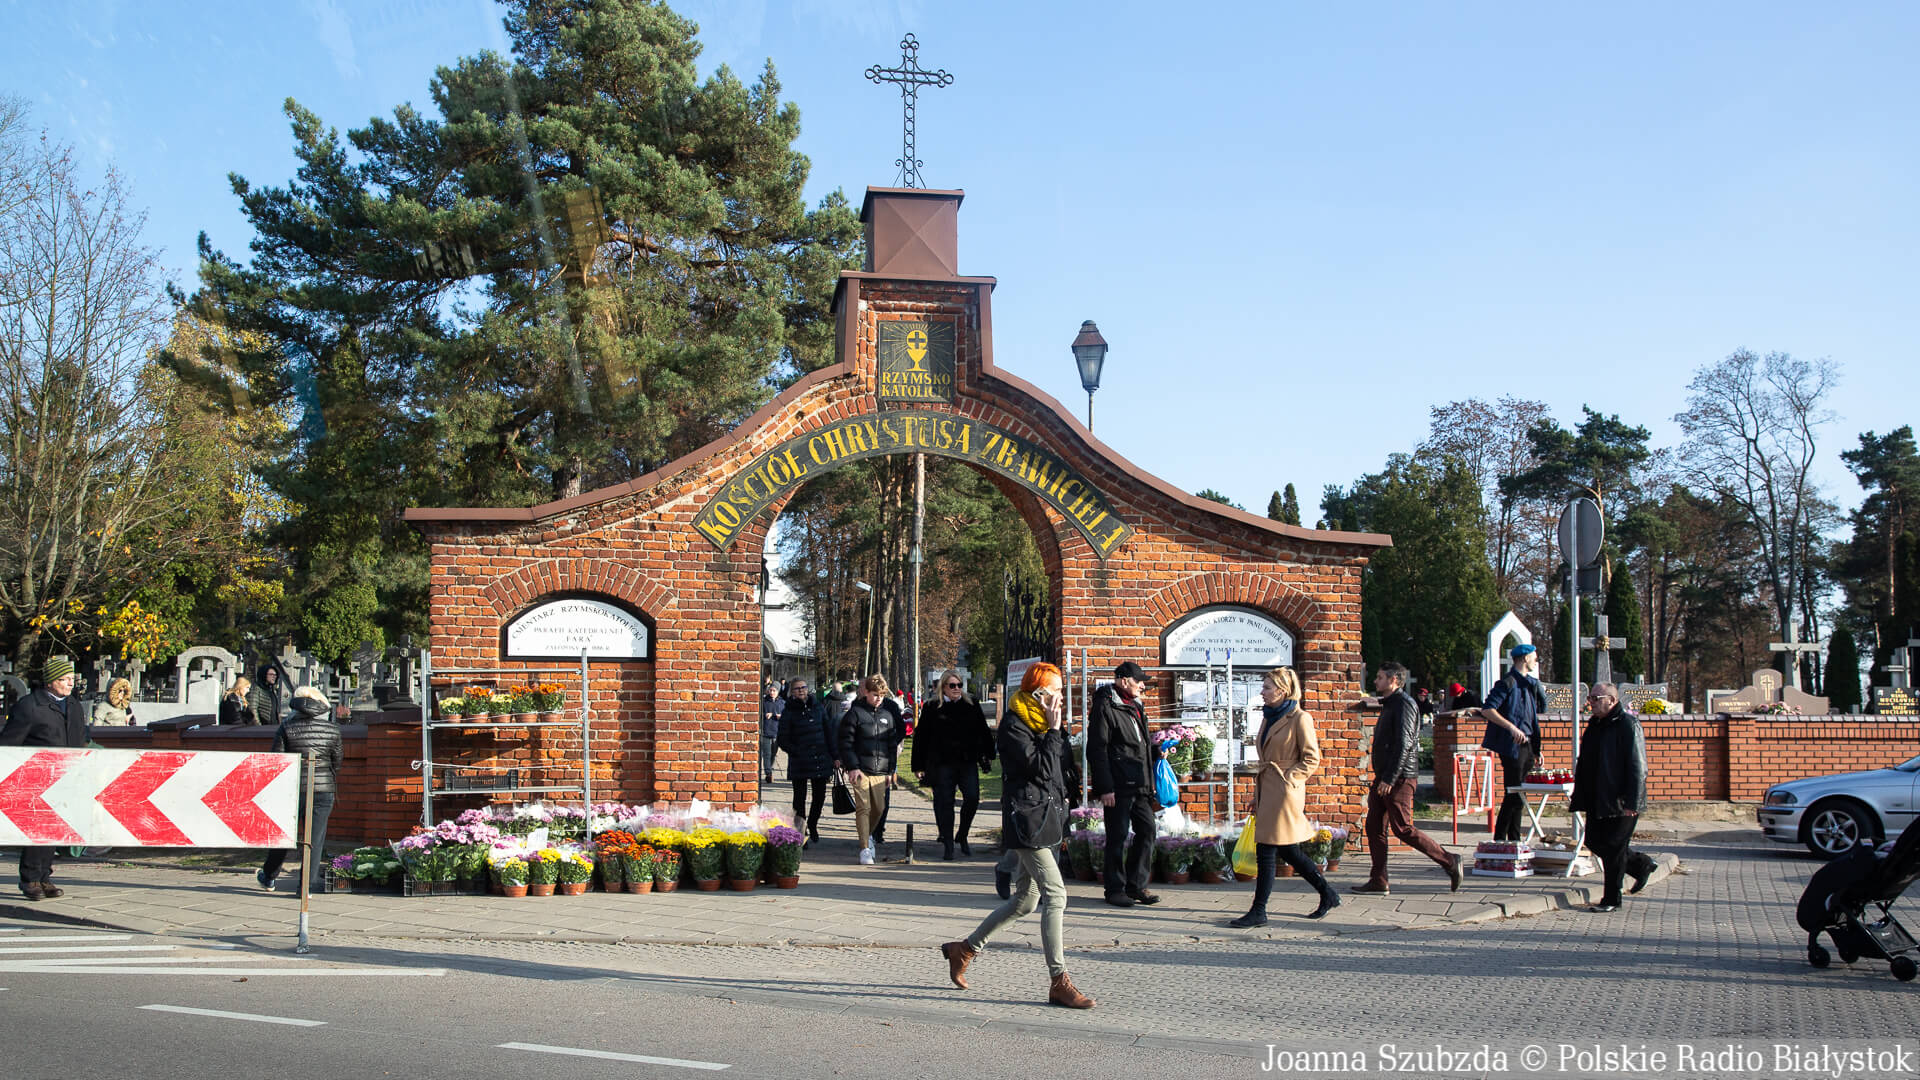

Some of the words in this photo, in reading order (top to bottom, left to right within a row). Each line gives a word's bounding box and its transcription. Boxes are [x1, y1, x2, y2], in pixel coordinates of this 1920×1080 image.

[882, 372, 951, 385] RZYMSKO
[881, 385, 951, 398] KATOLICKI
[699, 448, 809, 545] KOŚCIÓŁ
[808, 415, 971, 465] CHRYSTUSA
[979, 431, 1125, 551] ZBAWICIELA
[511, 608, 555, 639] CMENTARZ
[560, 605, 644, 641] RZYMSKOKATOLICKI
[1246, 618, 1263, 629] PANU
